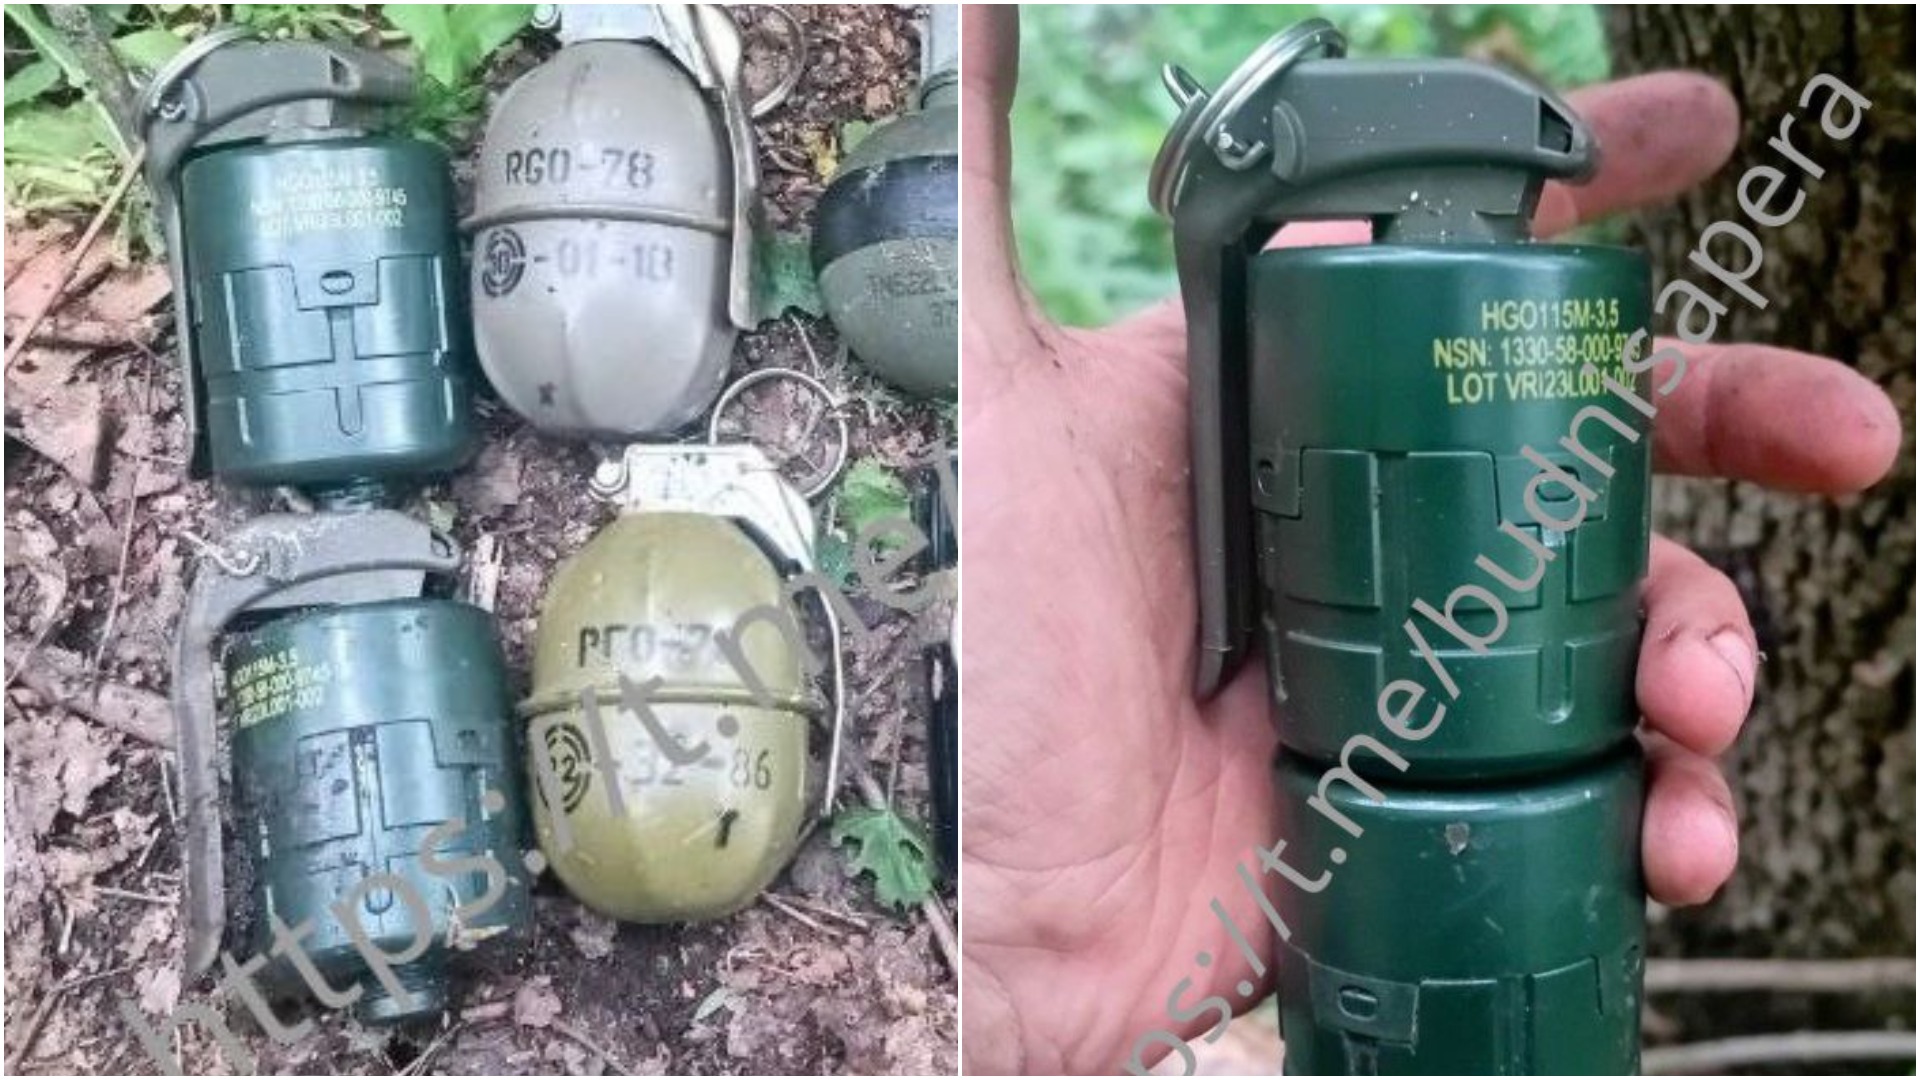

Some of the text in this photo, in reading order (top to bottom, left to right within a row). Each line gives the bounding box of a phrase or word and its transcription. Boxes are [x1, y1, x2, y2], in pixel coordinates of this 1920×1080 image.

[1481, 298, 1619, 332] HGO115M-3,5
[1433, 337, 1493, 369] NSN:
[1446, 372, 1498, 404] LOT
